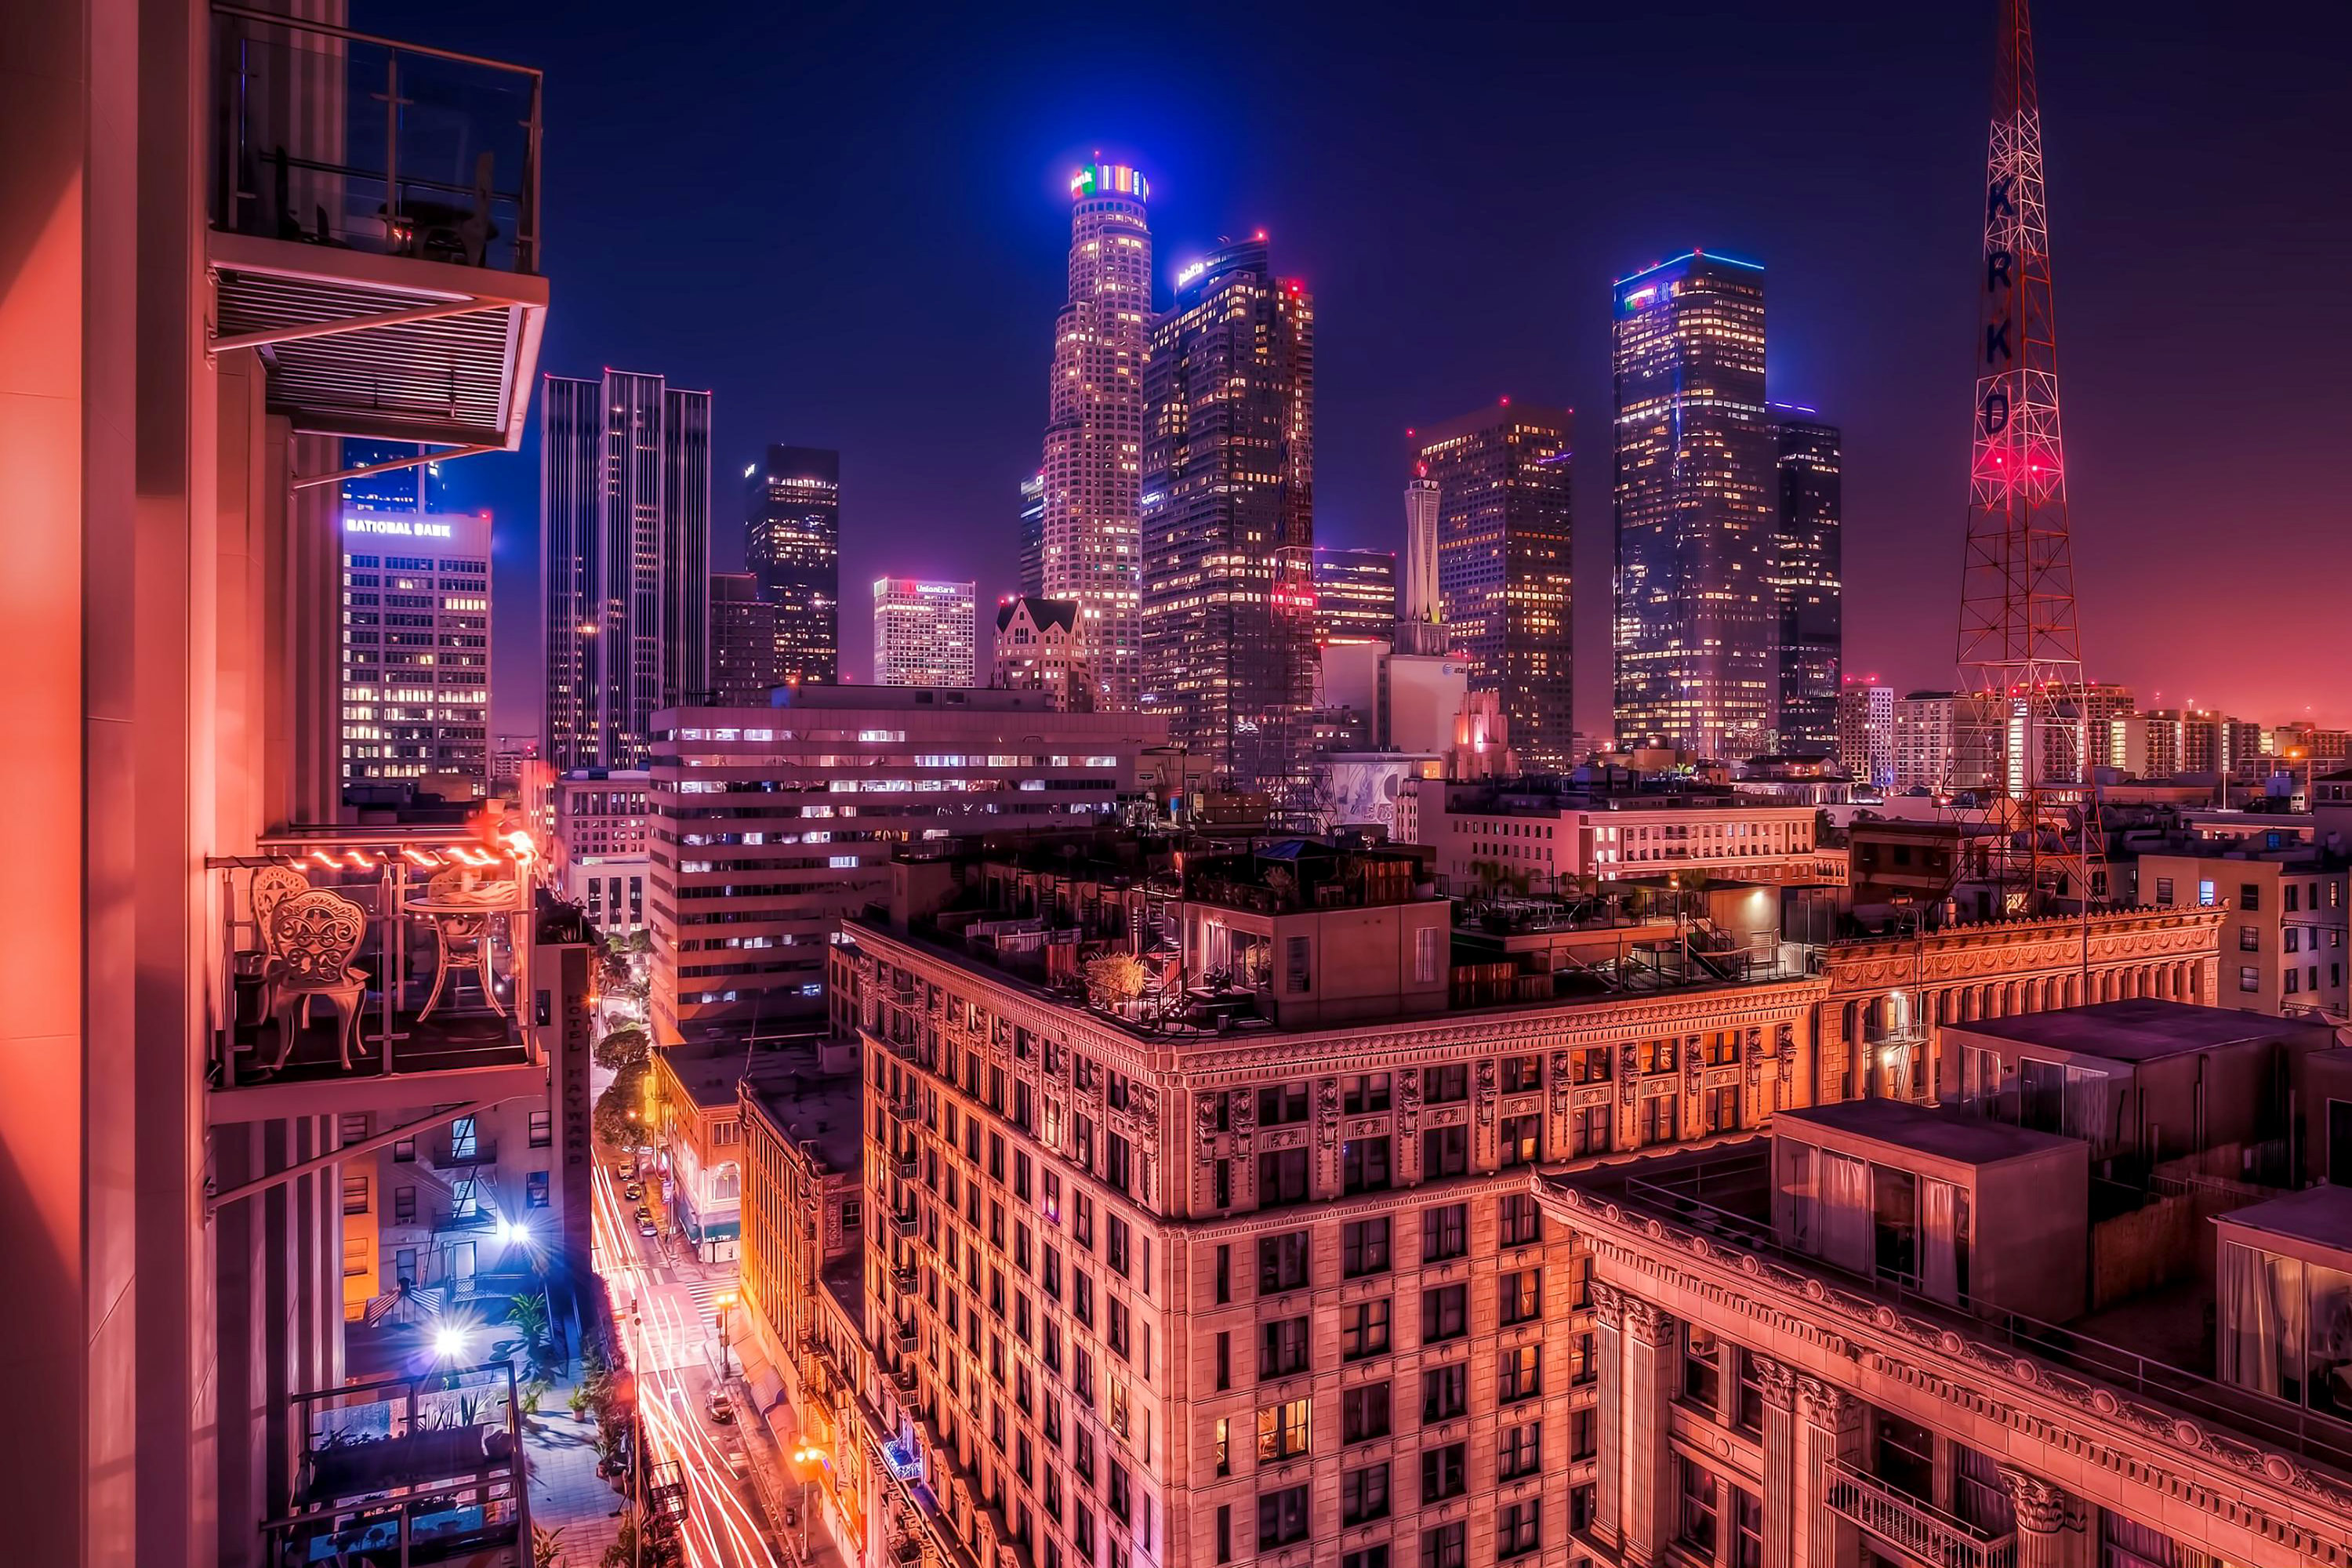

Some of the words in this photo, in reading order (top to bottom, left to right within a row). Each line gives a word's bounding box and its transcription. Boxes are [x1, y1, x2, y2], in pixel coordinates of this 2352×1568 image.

[347, 519, 412, 535] NATIONAL
[414, 523, 451, 538] BANK
[916, 584, 955, 593] UnionBank
[567, 994, 583, 1052] HOTEL
[567, 1068, 584, 1164] HAYWARD
